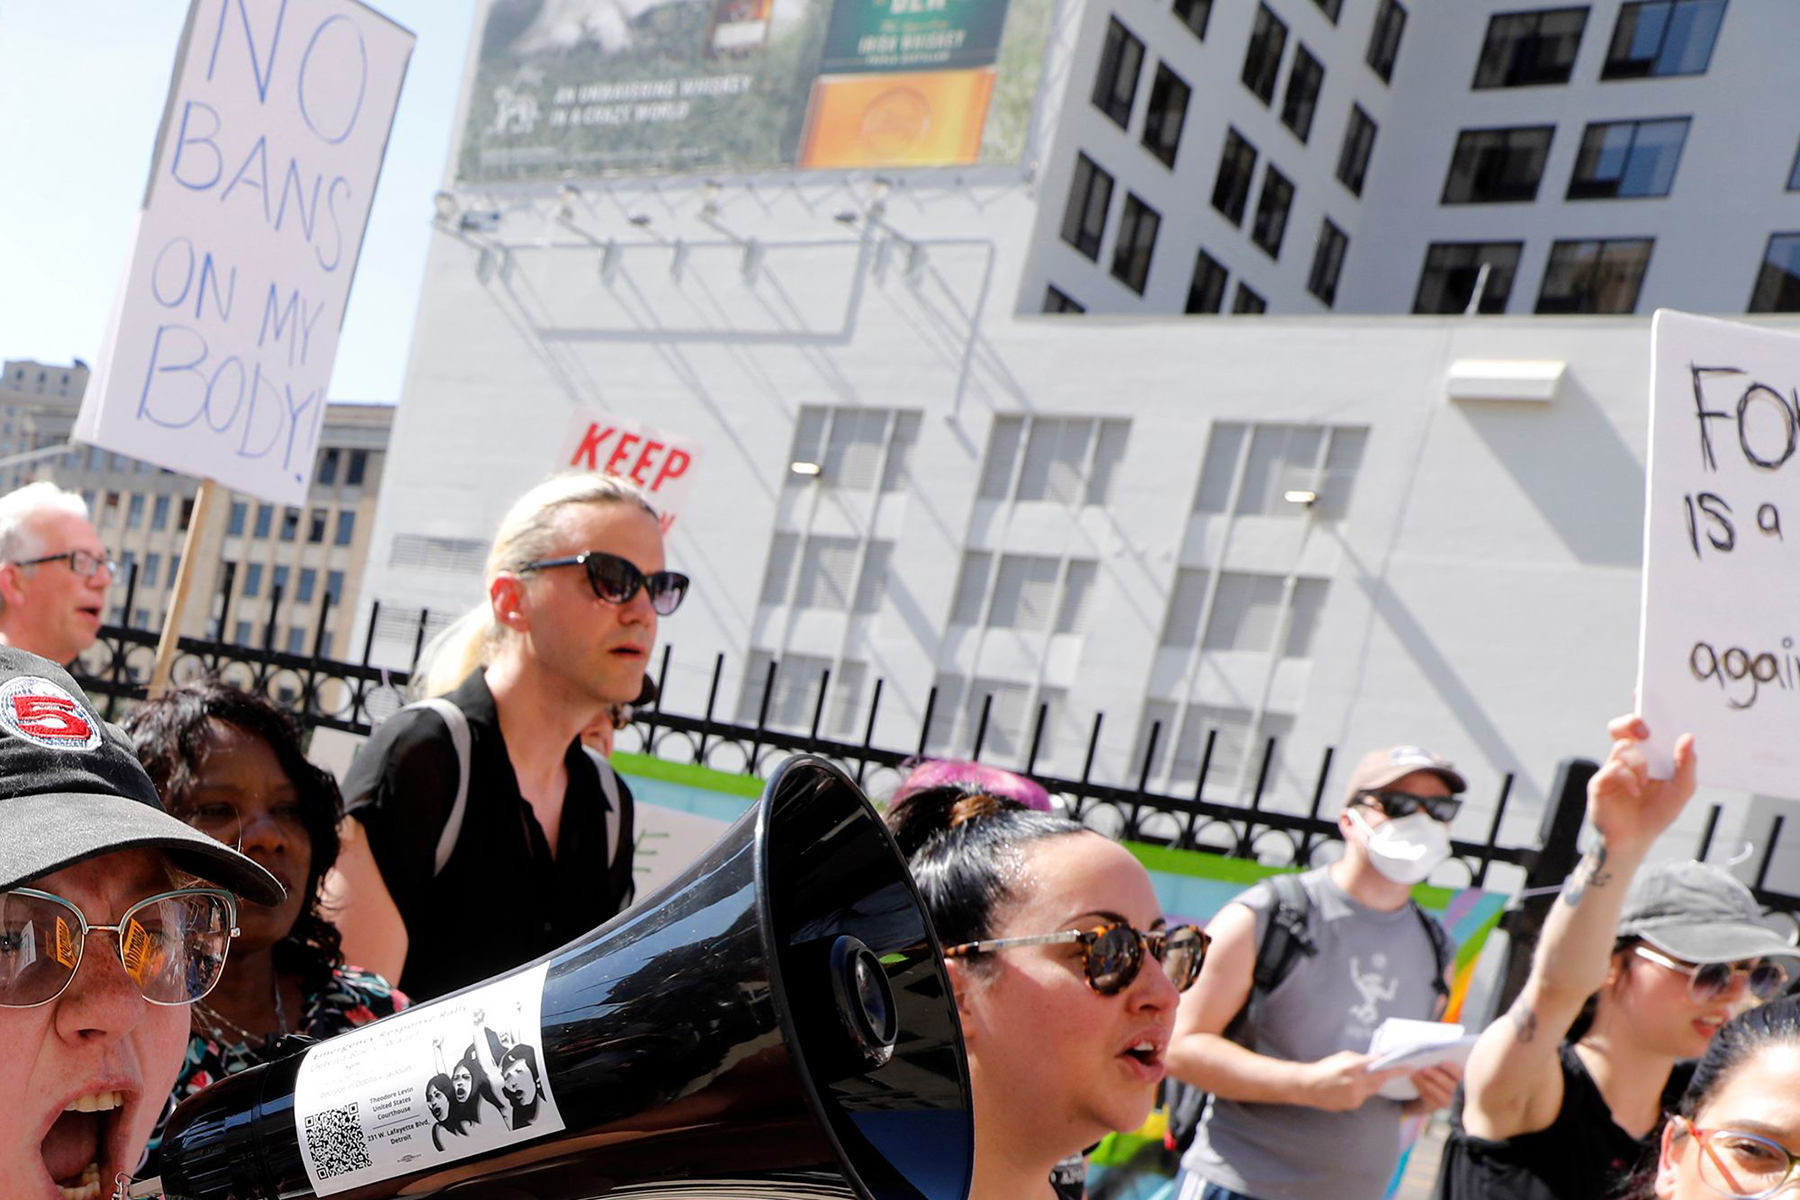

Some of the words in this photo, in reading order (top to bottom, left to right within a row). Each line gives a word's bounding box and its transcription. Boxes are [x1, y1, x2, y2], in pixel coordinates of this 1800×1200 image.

[207, 0, 368, 146] NO
[172, 101, 351, 272] BANS
[152, 236, 236, 322] ON
[258, 281, 326, 367] MY
[137, 323, 325, 484] BODY!
[570, 422, 691, 492] KEEP
[1684, 492, 1736, 563] IS
[1757, 502, 1785, 542] a
[12, 696, 91, 740] 5
[370, 1091, 397, 1104] Theodore
[398, 1087, 414, 1096] Levin
[373, 1101, 392, 1112] United
[393, 1097, 411, 1107] States
[377, 1106, 411, 1120] Courthouse
[367, 1133, 378, 1142] 231
[378, 1131, 387, 1139] W.
[387, 1124, 414, 1137] Lafayette
[390, 1134, 412, 1145] Detroit
